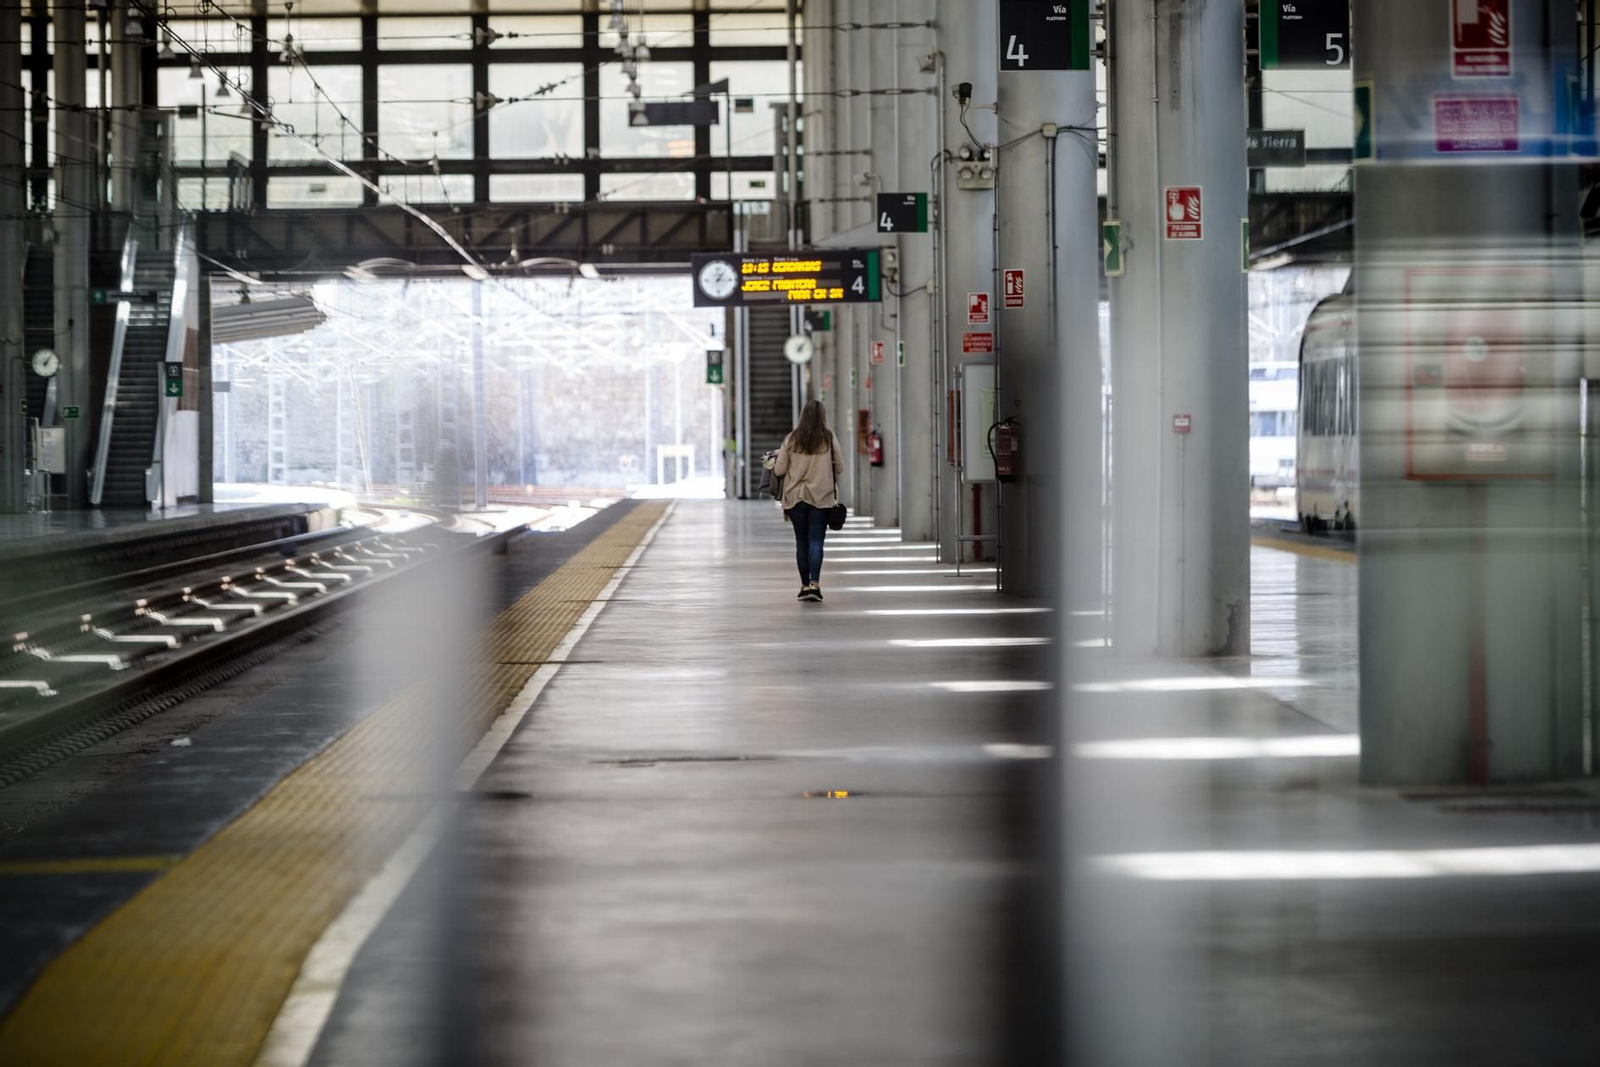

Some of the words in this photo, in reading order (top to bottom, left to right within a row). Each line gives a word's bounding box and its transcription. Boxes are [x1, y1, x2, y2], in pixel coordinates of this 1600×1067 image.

[1053, 5, 1066, 14] Vía
[1282, 4, 1296, 12] Vía
[1006, 35, 1029, 67] 4
[1325, 33, 1344, 66] 5
[1262, 136, 1297, 148] Tierra
[880, 211, 894, 231] 4
[852, 275, 865, 295] 4
